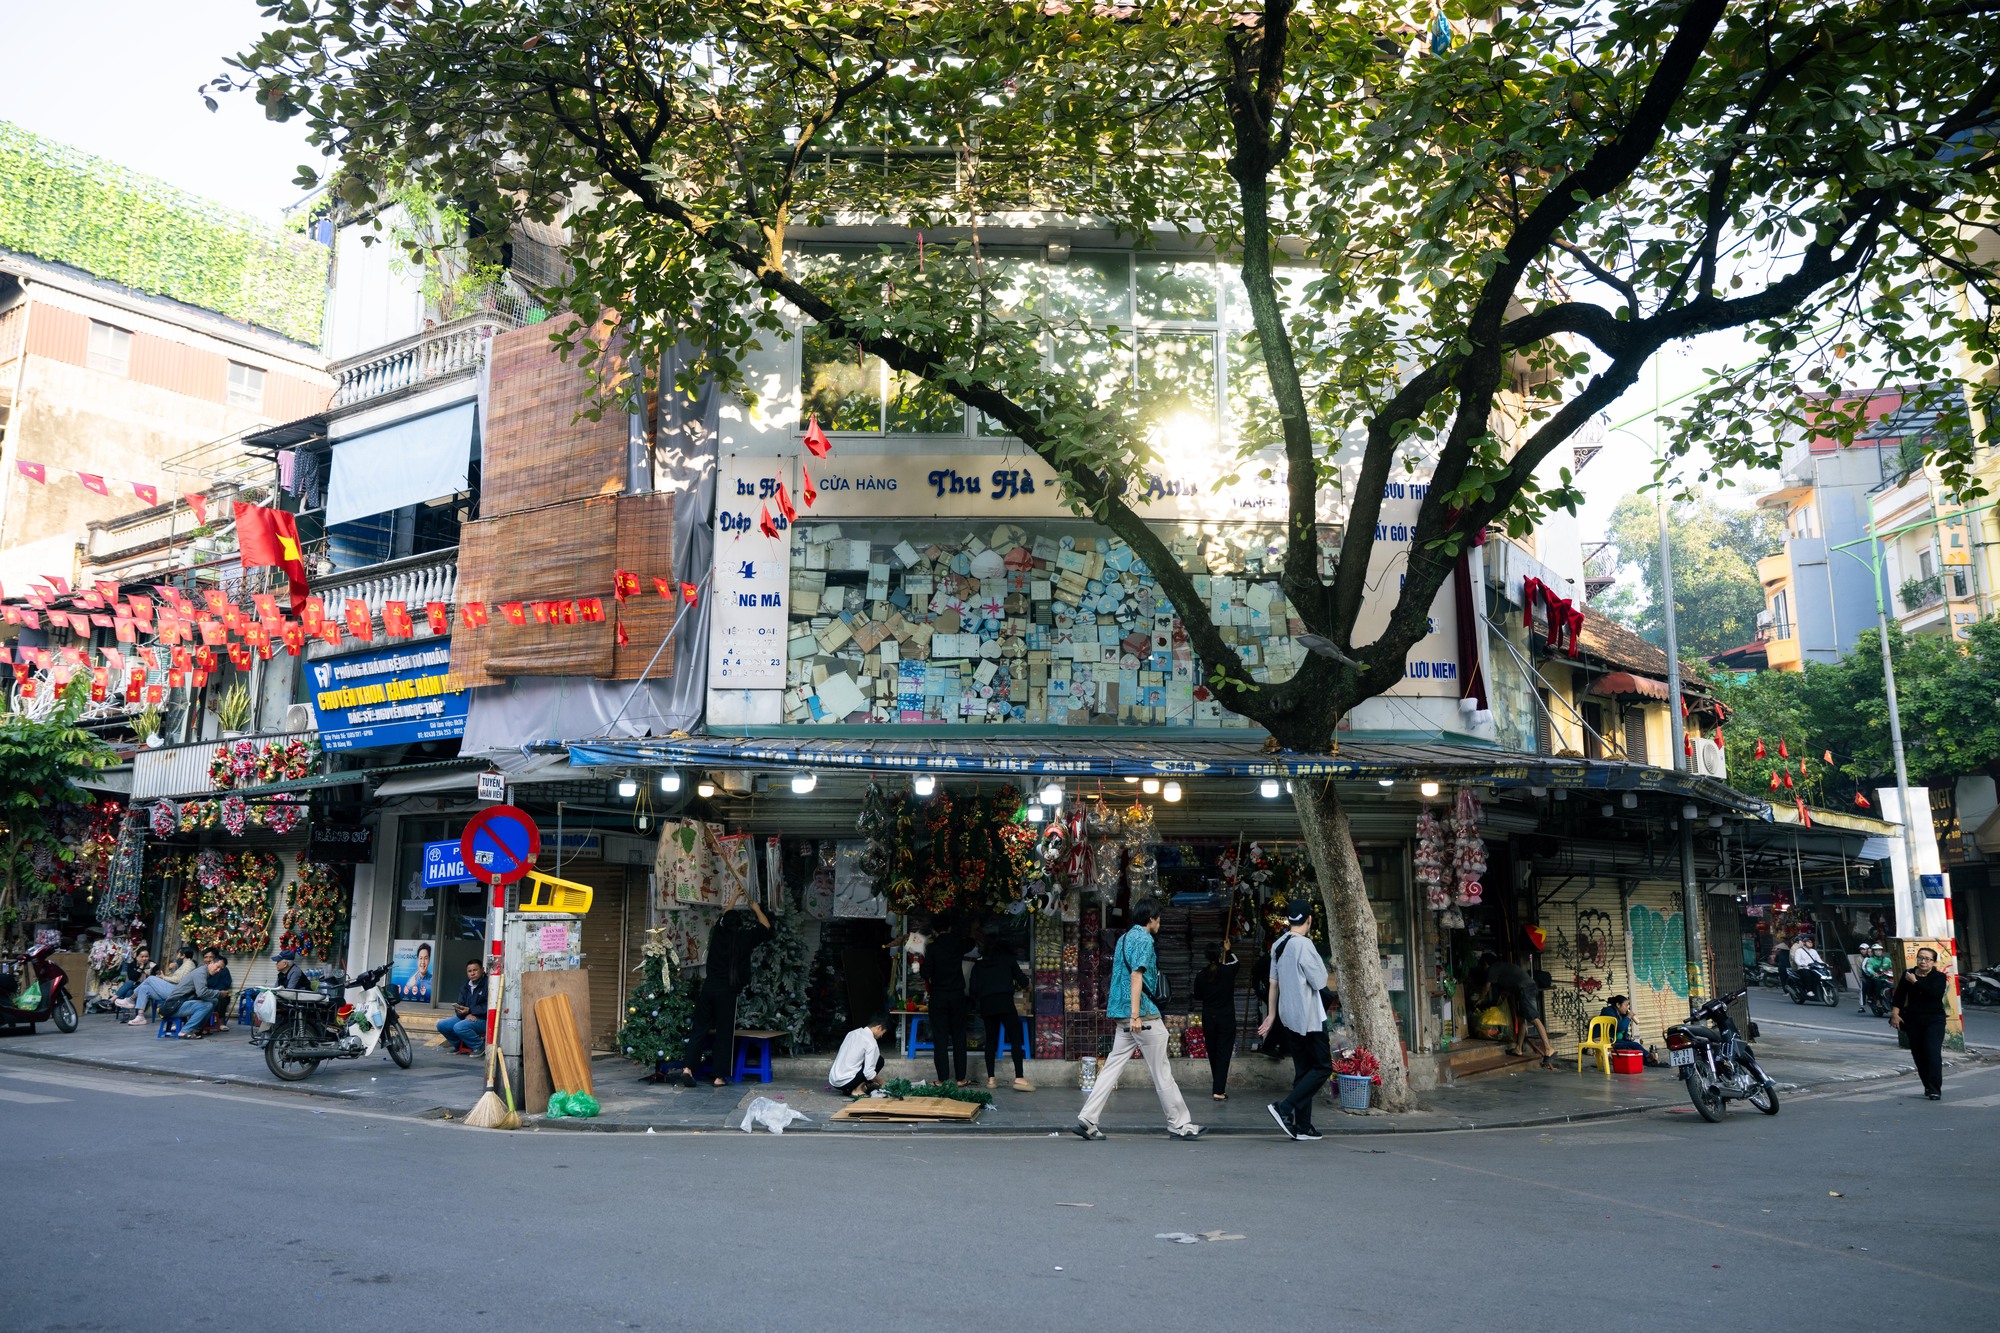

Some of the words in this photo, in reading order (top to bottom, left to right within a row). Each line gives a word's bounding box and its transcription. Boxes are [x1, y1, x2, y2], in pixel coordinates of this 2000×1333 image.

[819, 475, 850, 491] CỬA
[856, 474, 897, 491] HÀNG
[928, 469, 981, 497] Thu
[991, 468, 1035, 499] Hà
[1375, 520, 1387, 541] ẤY
[1391, 522, 1407, 542] GÓI
[761, 591, 781, 607] MÃ
[1410, 660, 1429, 679] LƯU
[1432, 659, 1456, 682] NIỆM
[317, 685, 358, 710] CHUYÊN
[356, 683, 387, 705] KHOA
[386, 678, 417, 702] RĂNG
[414, 673, 444, 697] HÀM
[429, 859, 464, 880] HÀNG
